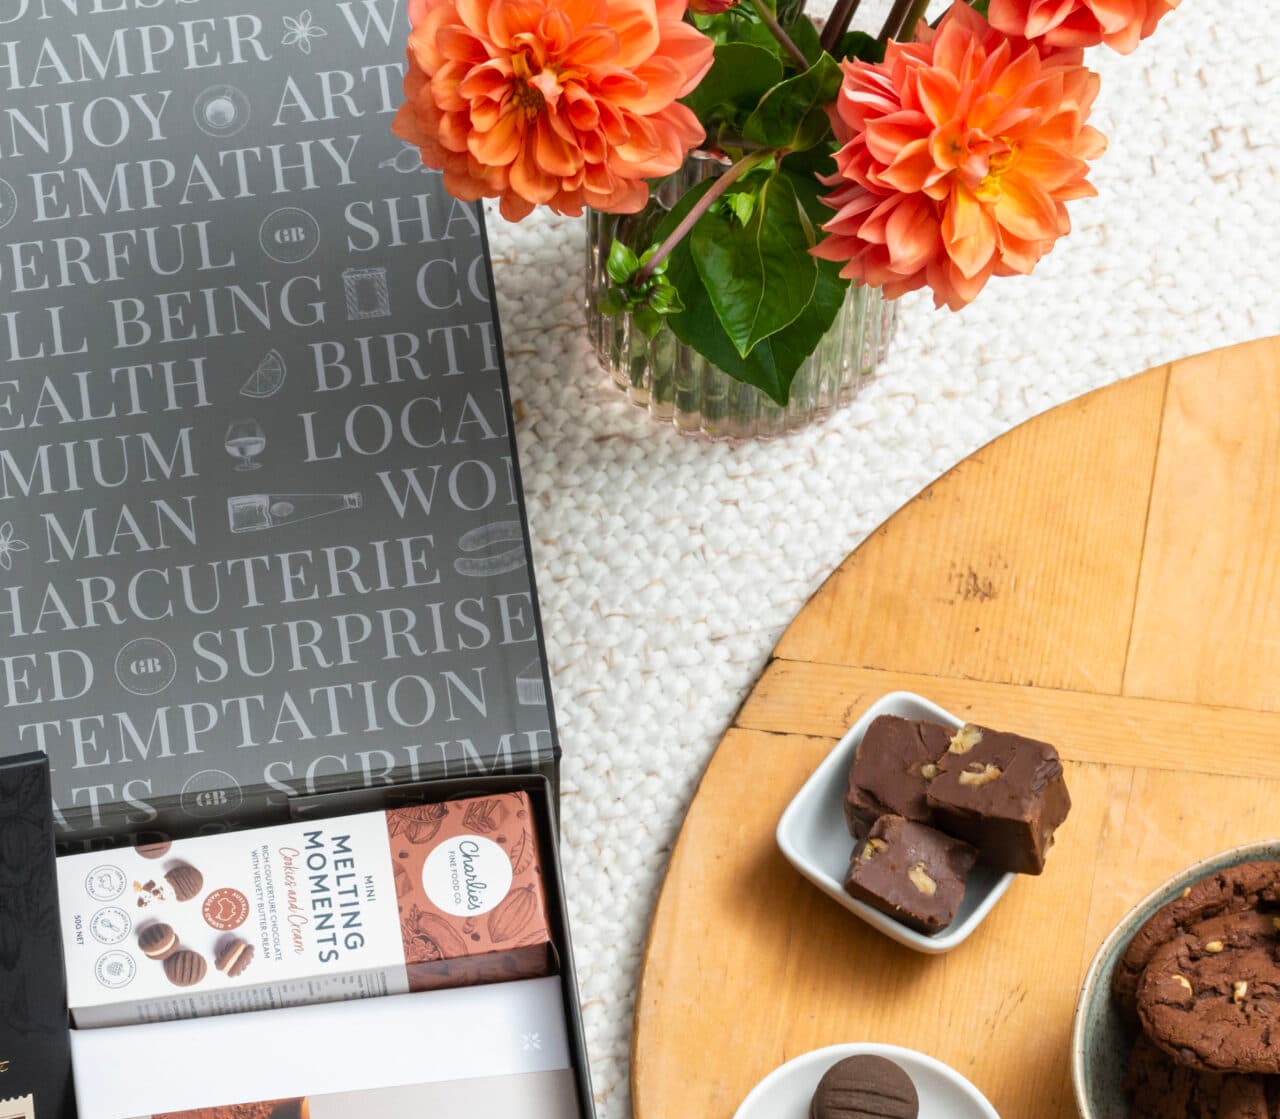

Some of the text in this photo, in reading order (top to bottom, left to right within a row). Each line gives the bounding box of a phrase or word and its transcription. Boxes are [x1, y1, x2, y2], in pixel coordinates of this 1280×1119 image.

[272, 62, 404, 127] ART
[28, 135, 362, 223] EMPATHY
[107, 275, 327, 350] BEING
[298, 388, 510, 462] LOCA
[40, 496, 197, 563] MAN
[192, 591, 538, 683] SURPRISE
[19, 667, 488, 772] TEMPTATION
[278, 847, 300, 887] Cookies
[331, 835, 365, 950] MELTING
[365, 876, 376, 902] MINI
[447, 851, 456, 868] FINE
[450, 869, 460, 891] FOOD
[459, 840, 487, 911] Charlie's
[258, 901, 266, 929] BUTTER
[261, 845, 282, 960] RICH COUVERTURE CHOCOLATE
[304, 830, 339, 963] MOMENTS
[75, 931, 84, 945] NET
[261, 930, 270, 959] CREAM
[287, 912, 308, 956] Cream
